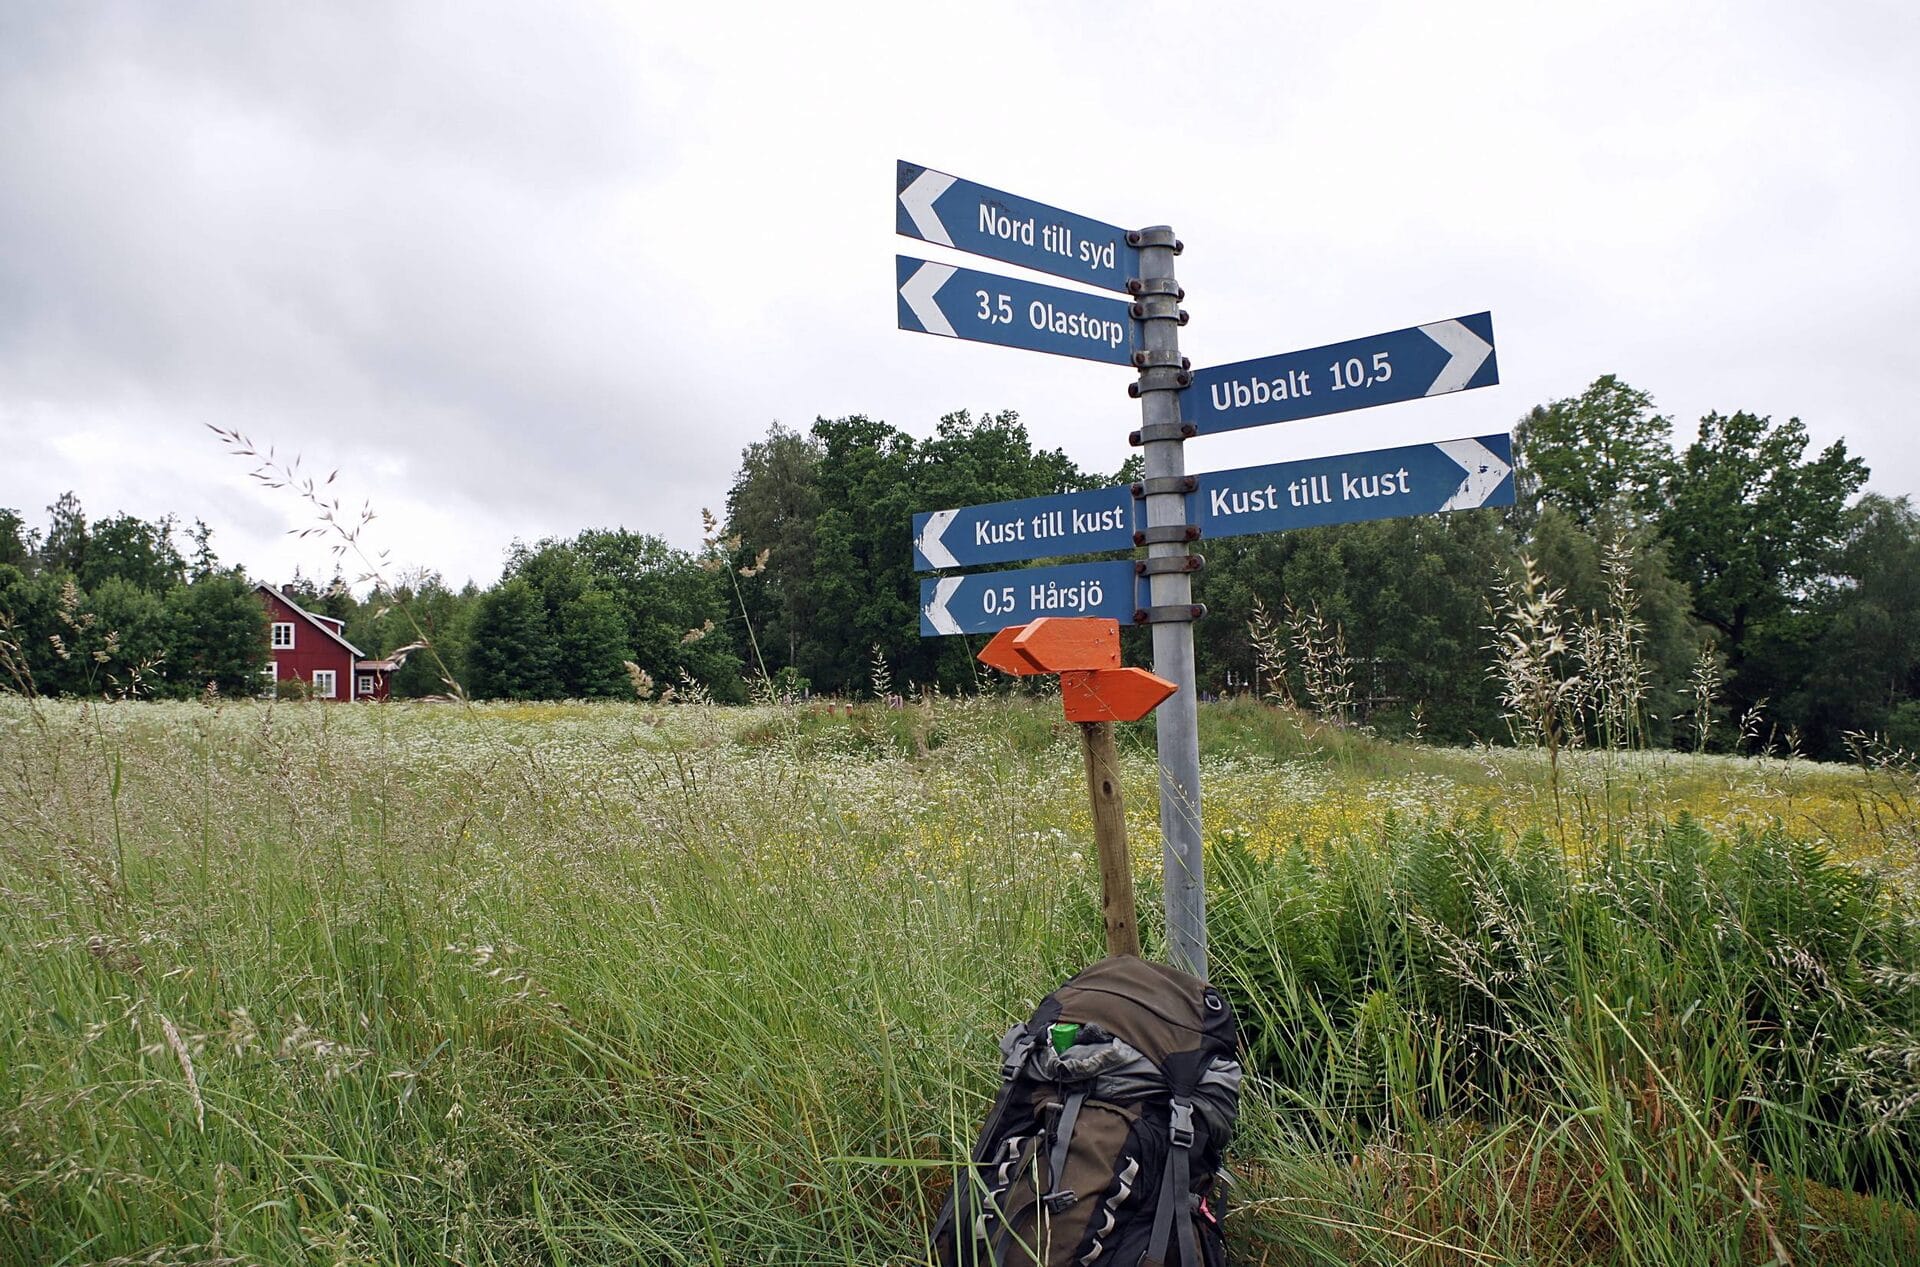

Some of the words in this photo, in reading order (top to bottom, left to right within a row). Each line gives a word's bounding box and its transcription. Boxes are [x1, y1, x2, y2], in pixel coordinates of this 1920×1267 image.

[979, 203, 1034, 247] Nord
[1042, 225, 1073, 257] till
[1079, 240, 1115, 270] syd
[975, 290, 1013, 325] 3,5
[1029, 300, 1123, 348] Olastorp
[1211, 370, 1311, 411] Ubbalt
[1329, 352, 1392, 391] 10,5
[1210, 484, 1277, 517] Kust
[1288, 475, 1332, 507] till
[1342, 467, 1410, 499] kust
[975, 519, 1024, 546] Kust
[1031, 509, 1064, 537] till
[1073, 505, 1124, 534] kust
[983, 587, 1015, 615] 0,5
[1030, 580, 1103, 612] Hårsjö
